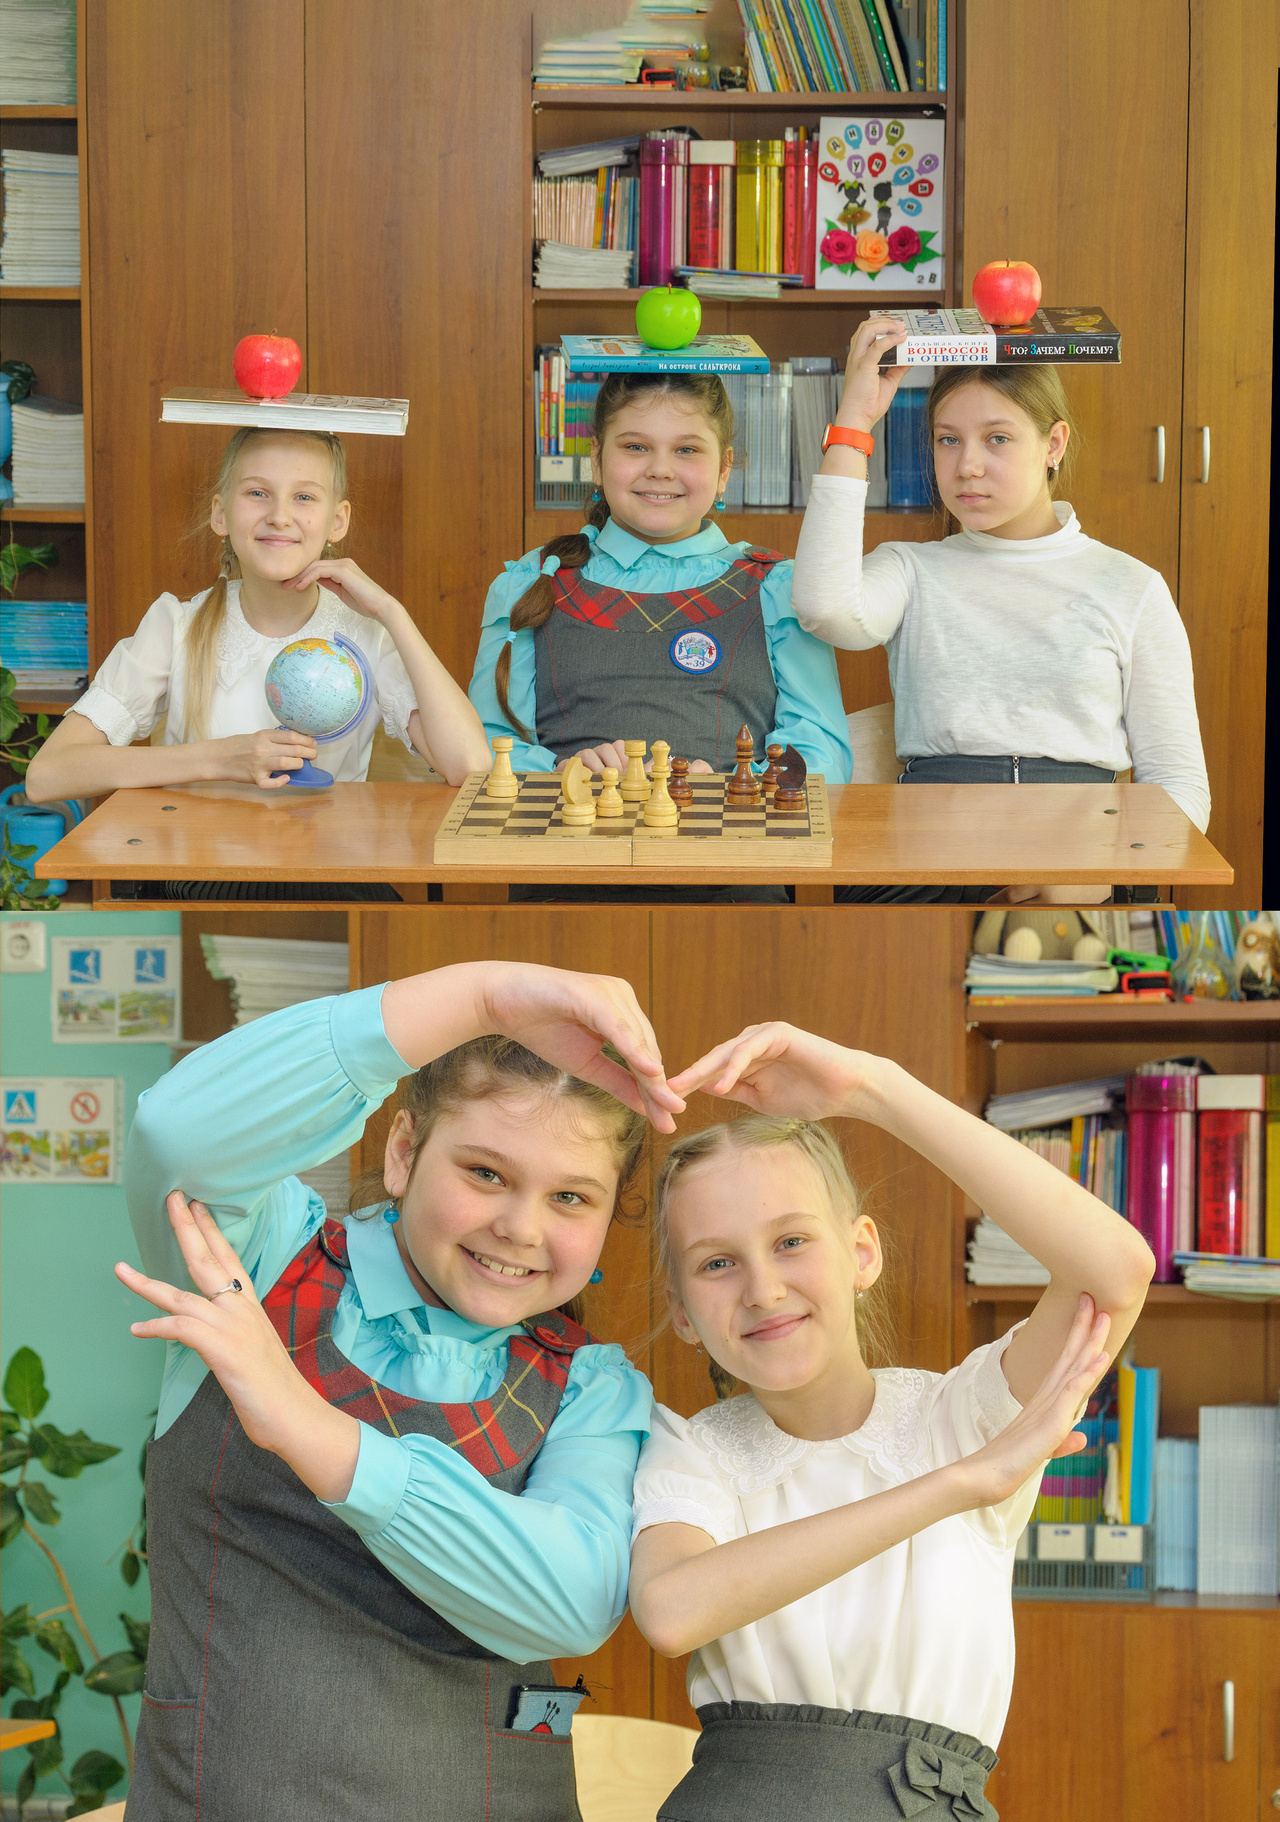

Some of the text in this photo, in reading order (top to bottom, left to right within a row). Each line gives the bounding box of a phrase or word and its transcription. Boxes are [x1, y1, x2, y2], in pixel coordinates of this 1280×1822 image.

[907, 346, 989, 355] ВОПРОСОВ
[920, 354, 989, 363] ОТВЕТОВ
[699, 363, 741, 371] САЛЬТКРОКА
[693, 660, 705, 668] 39
